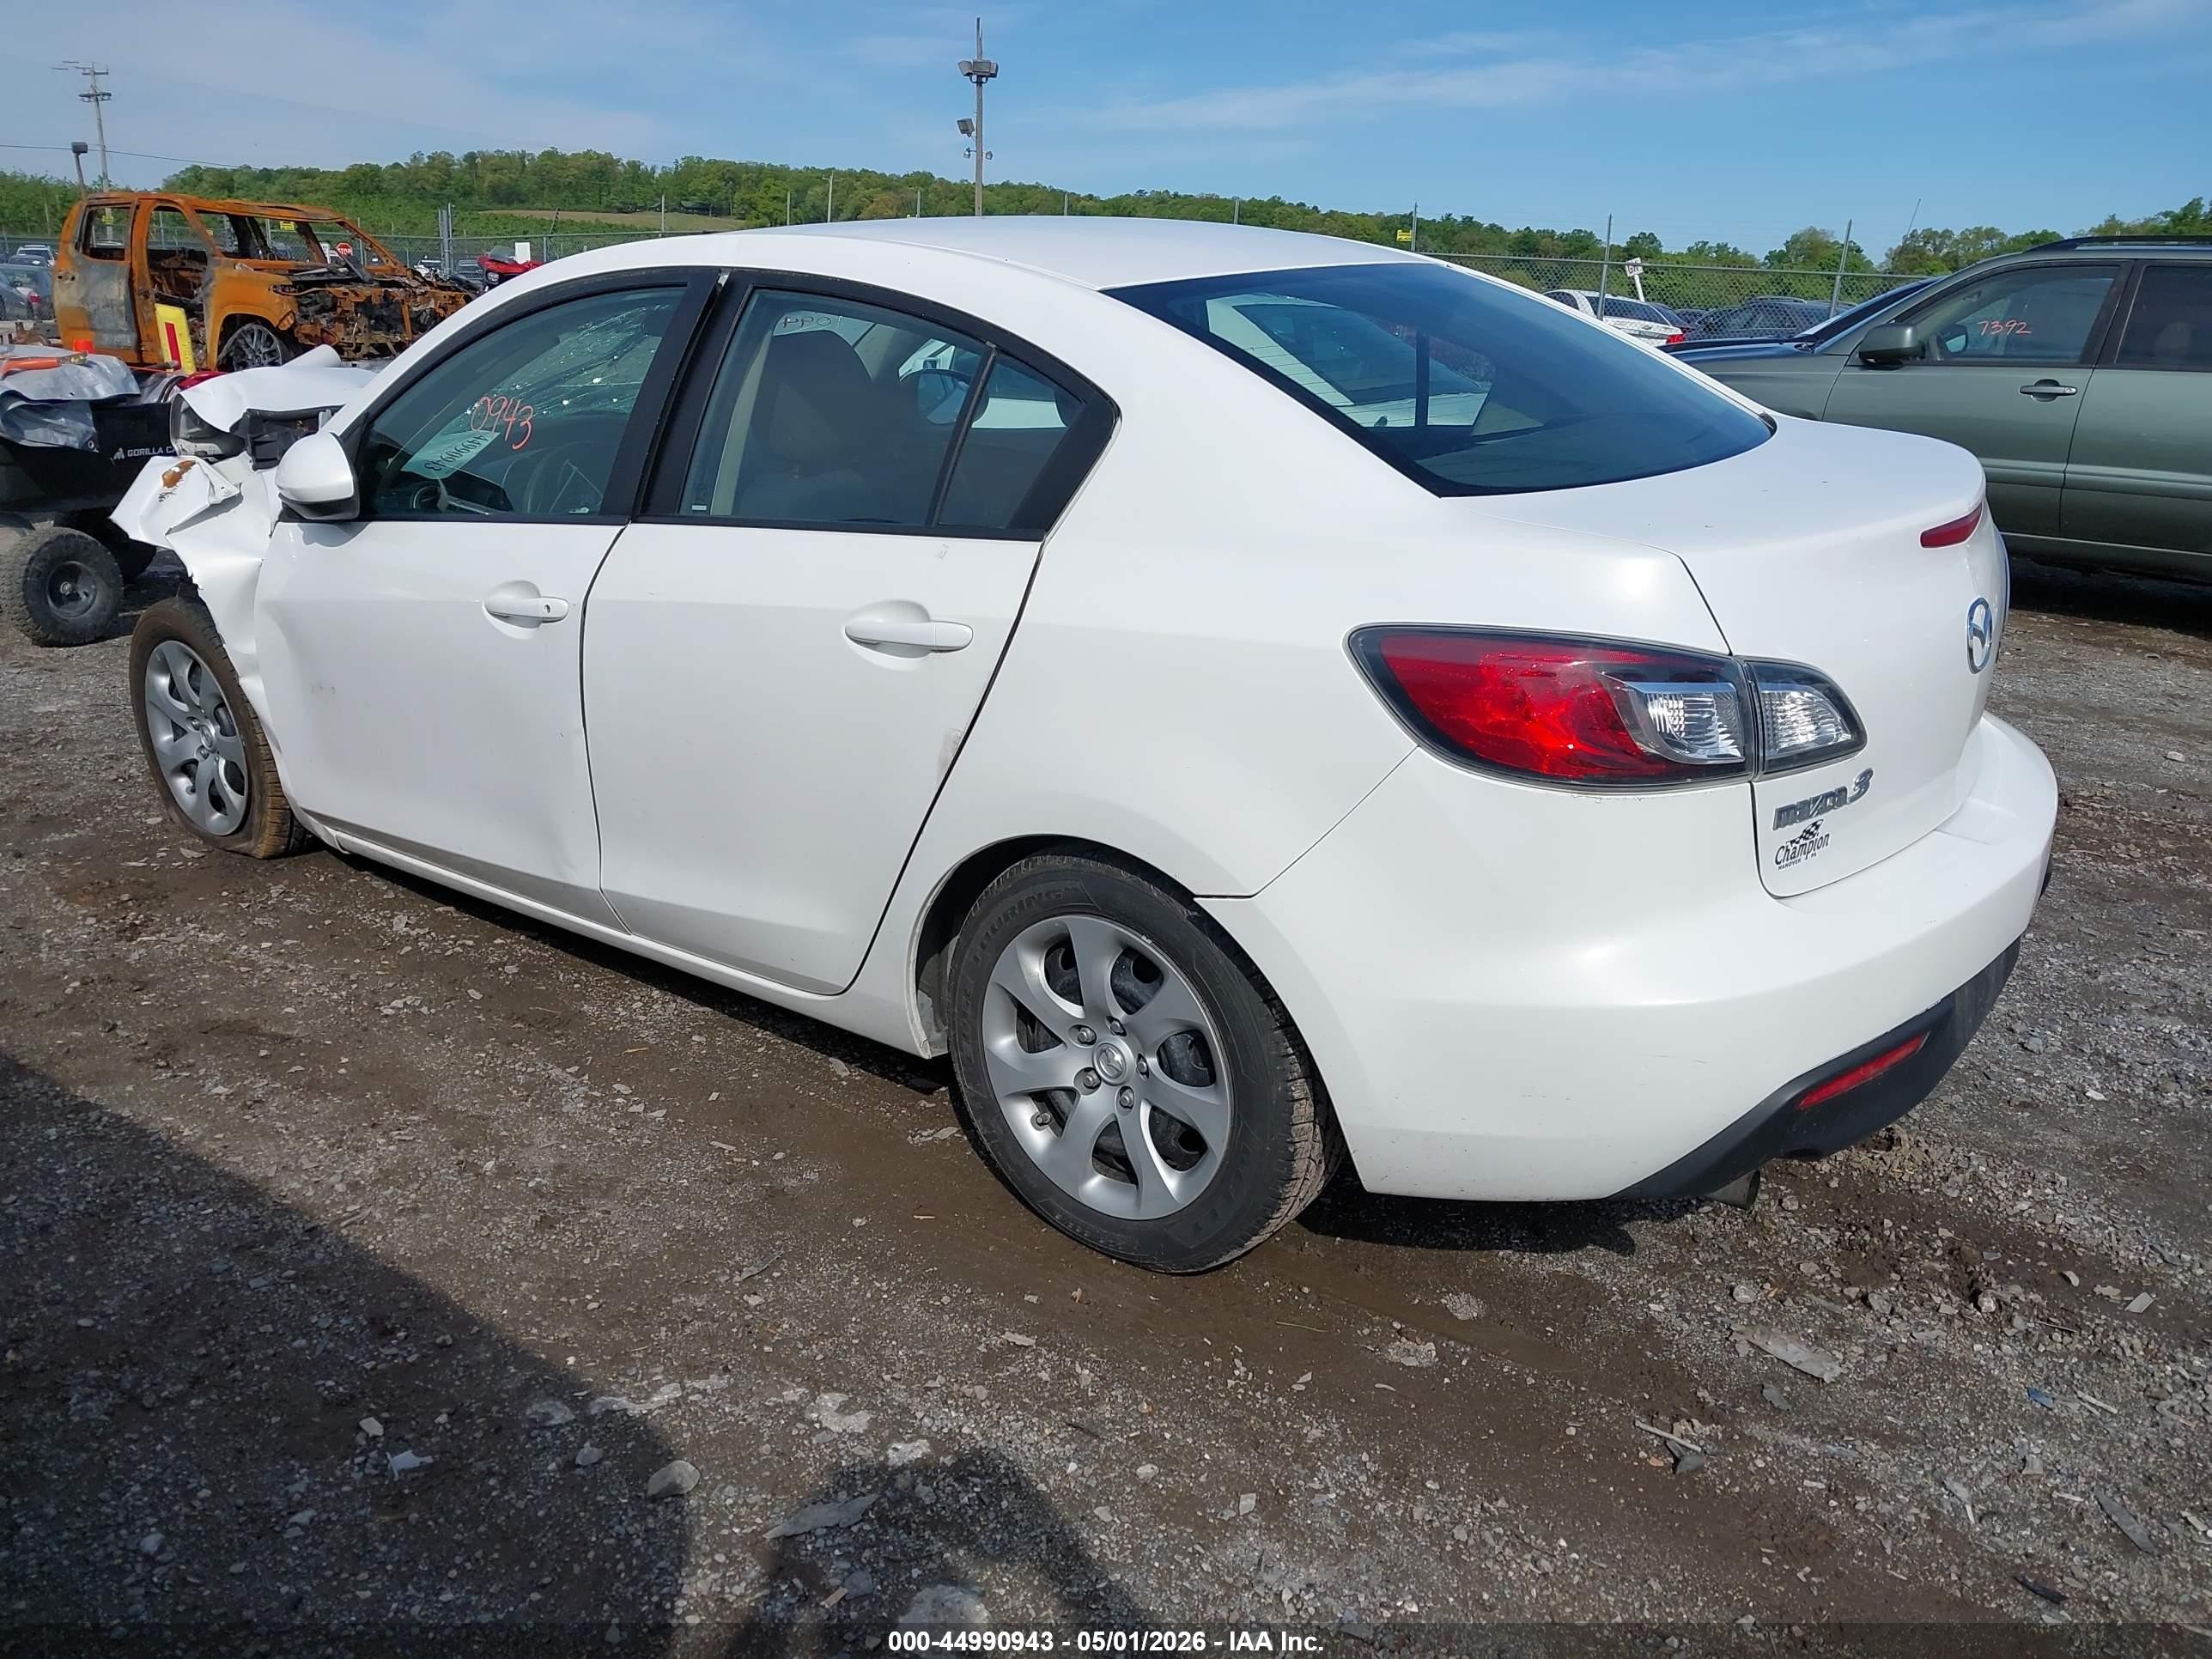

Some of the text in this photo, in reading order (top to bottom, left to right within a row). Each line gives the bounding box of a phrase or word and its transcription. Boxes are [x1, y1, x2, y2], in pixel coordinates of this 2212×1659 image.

[337, 246, 352, 256] STOP
[1978, 319, 2033, 337] 7392
[471, 396, 534, 450] 0943
[127, 447, 163, 457] GORILLA
[424, 434, 489, 471] 44990943
[1775, 833, 1830, 865] Champion
